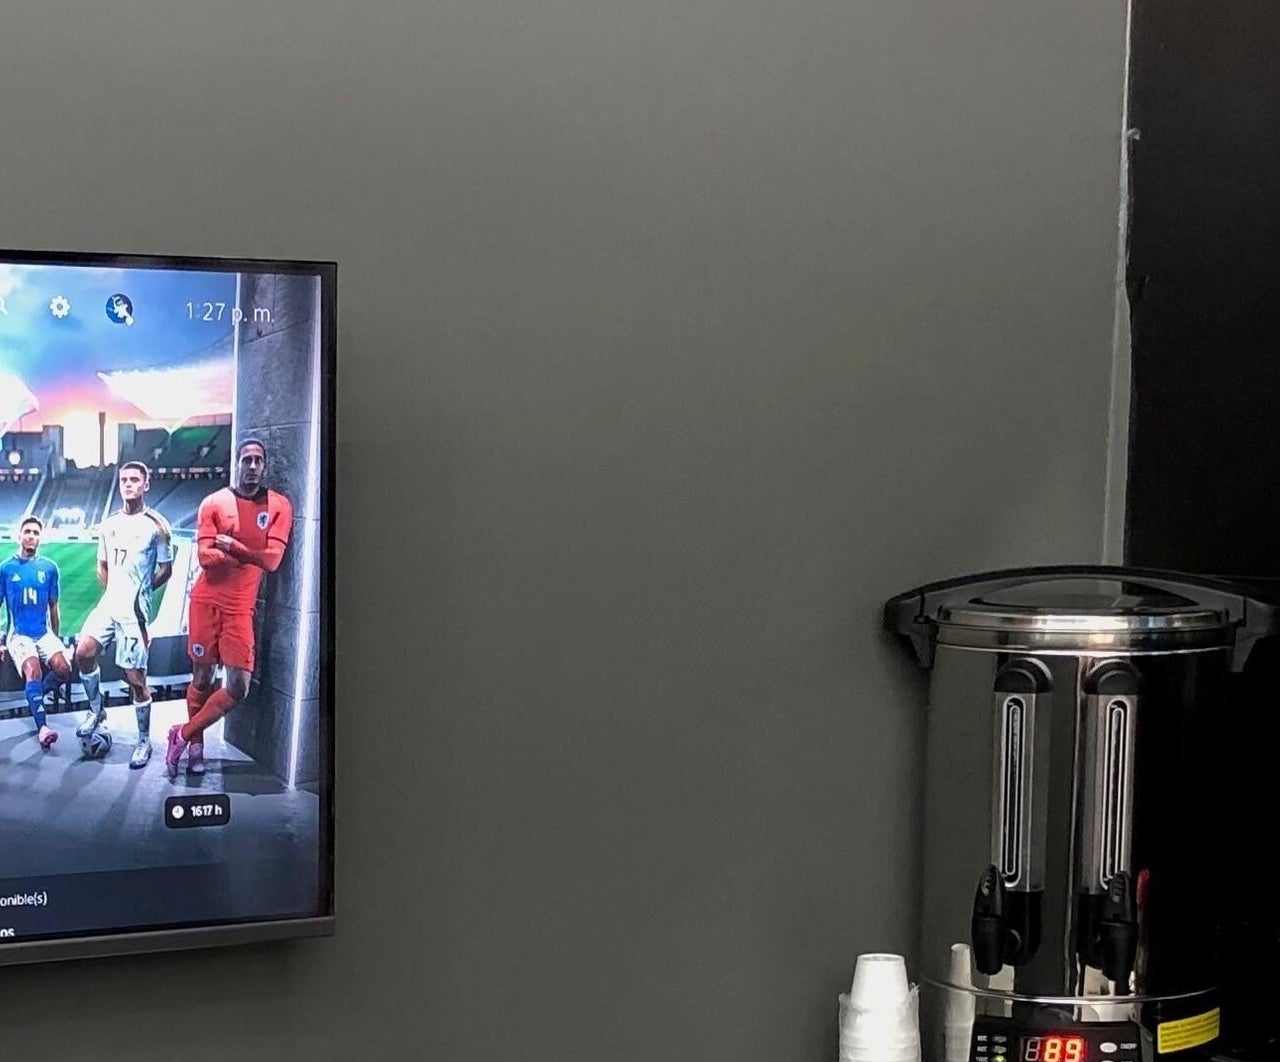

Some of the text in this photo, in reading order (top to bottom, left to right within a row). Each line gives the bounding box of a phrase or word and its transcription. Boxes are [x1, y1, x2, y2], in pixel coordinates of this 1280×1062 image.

[186, 302, 226, 321] 1:27
[190, 805, 223, 818] 1617 h
